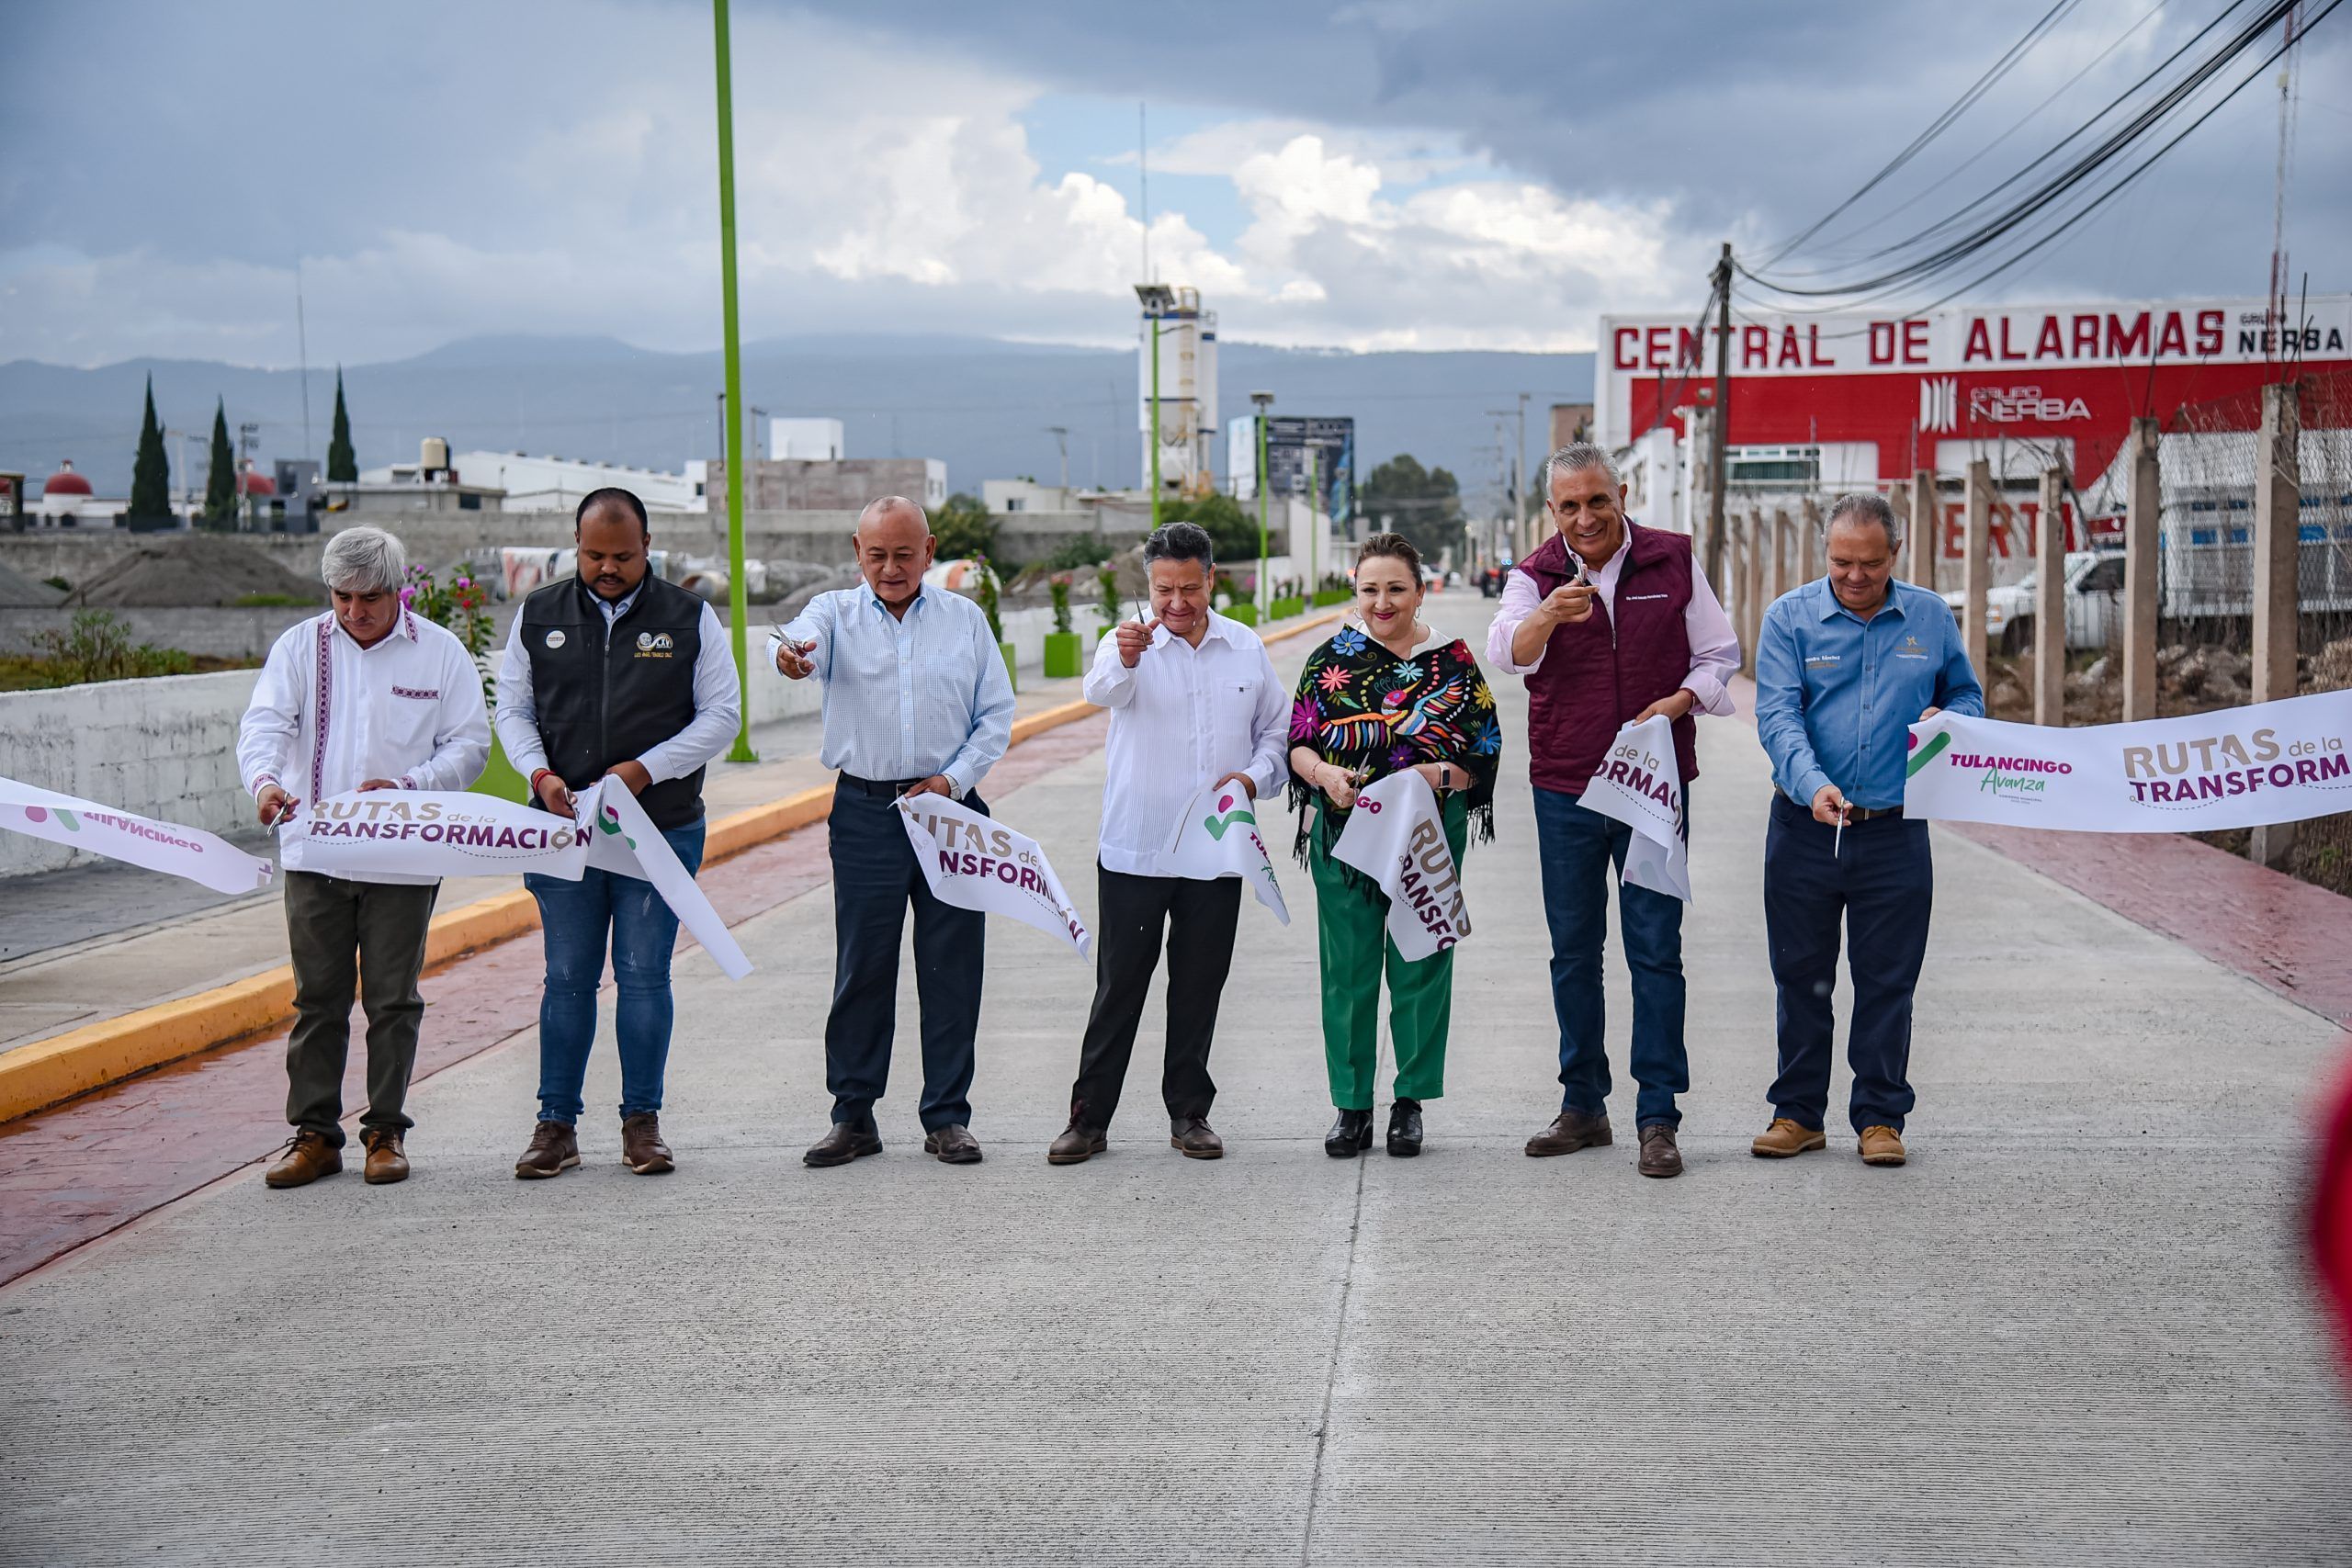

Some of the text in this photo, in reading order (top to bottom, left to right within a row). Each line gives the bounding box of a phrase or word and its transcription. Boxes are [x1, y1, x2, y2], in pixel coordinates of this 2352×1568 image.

[1869, 321, 1928, 365] DE
[1963, 310, 2224, 362] ALARMAS
[2239, 328, 2345, 353] NERBA
[1971, 386, 2042, 401] GRUPO
[1970, 397, 2092, 423] NERBA
[1614, 744, 1660, 772] de la
[1951, 753, 2073, 774] TULANCINGO
[2122, 728, 2343, 779] RUTAS de la
[1980, 767, 2045, 795] Avanza
[2129, 753, 2351, 803] TRANSFORM
[447, 812, 472, 823] de
[478, 814, 497, 823] la
[308, 820, 593, 850] RANSFORMACIÓN
